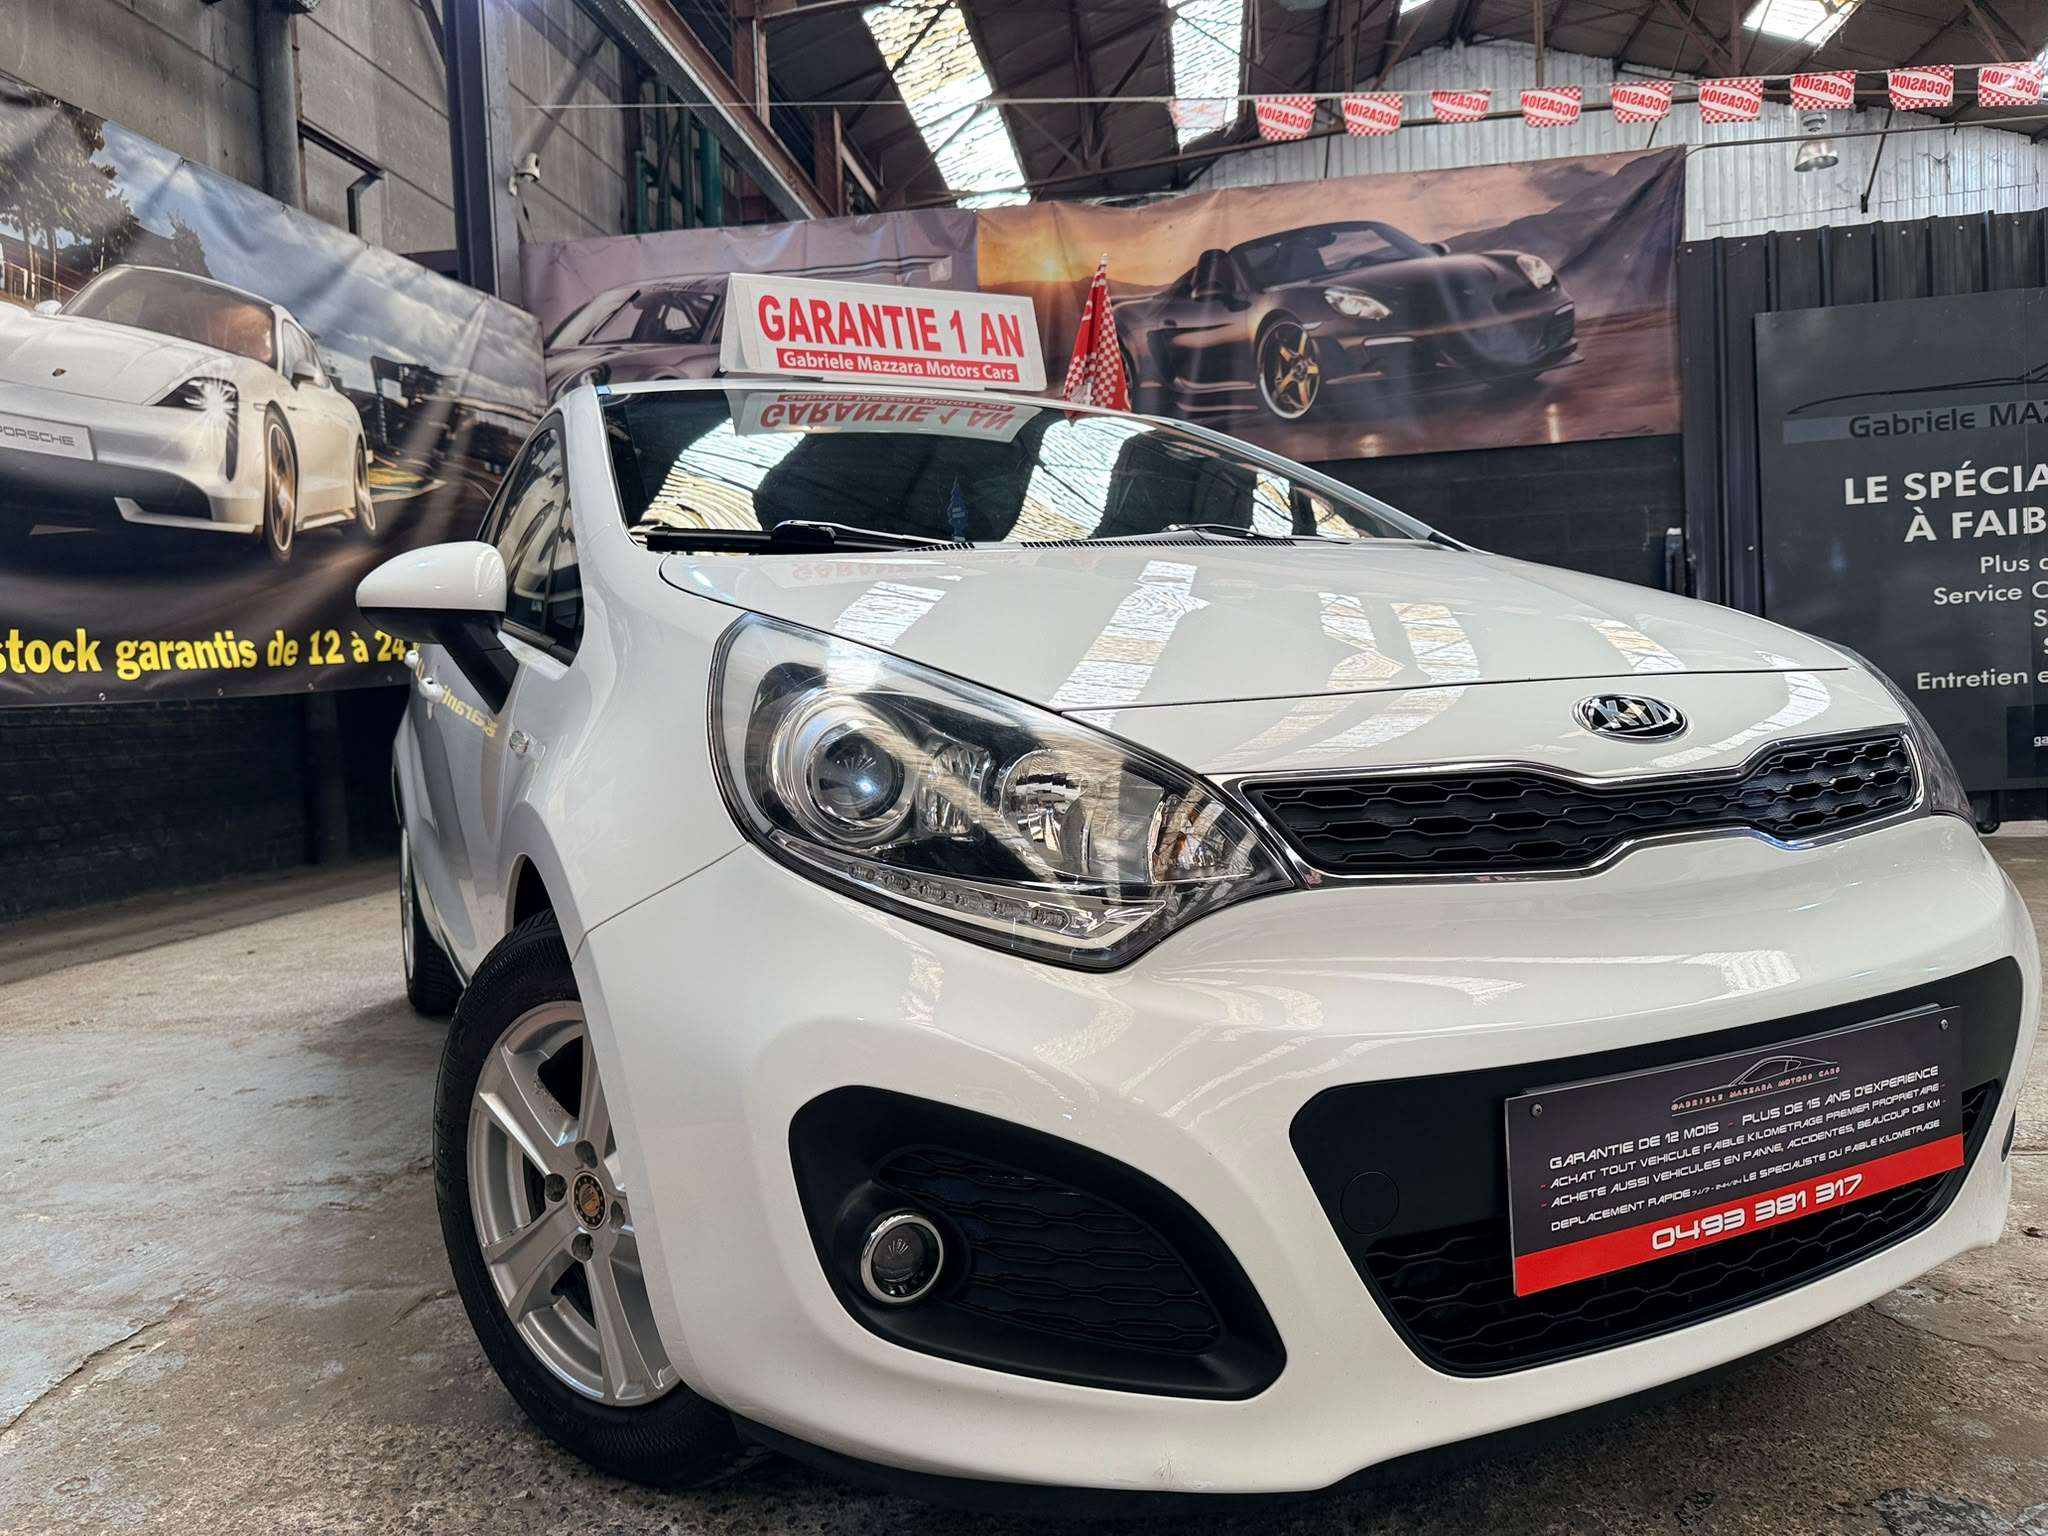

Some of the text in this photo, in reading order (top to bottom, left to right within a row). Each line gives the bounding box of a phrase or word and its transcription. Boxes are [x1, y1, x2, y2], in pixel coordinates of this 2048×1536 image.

[758, 295, 1025, 358] GARANTIE 1 AN
[784, 351, 1015, 381] Gabriele Mazzara Motors Cars
[0, 425, 75, 446] ORSCHE
[1849, 401, 2048, 438] Gabriele MA
[1845, 460, 2048, 505] LE SPÉCIA
[1904, 506, 2047, 542] À FAIB
[1981, 555, 2030, 574] Plus
[1933, 584, 2023, 606] Service
[116, 630, 258, 681] garantis
[267, 629, 299, 668] de
[309, 629, 345, 665] 12
[351, 631, 369, 664] à
[374, 630, 406, 662] 24
[1917, 668, 2028, 690] Entretien
[1597, 699, 1679, 729] KIA
[1550, 1141, 1634, 1170] GARANTIE
[1638, 1135, 1661, 1151] DE
[1665, 1131, 1680, 1144] 12
[1683, 1122, 1720, 1141] MOIS
[1742, 1108, 1781, 1126] PLUS
[1784, 1101, 1804, 1116] DE
[1807, 1097, 1821, 1111] 15
[1824, 1090, 1851, 1106] ANS
[1854, 1066, 1939, 1097] D'EXPERIENCE
[1550, 1169, 1596, 1190] ACHAT
[1600, 1161, 1637, 1177] TOUT
[1640, 1147, 1701, 1169] VEHICULE
[1703, 1135, 1745, 1154] FAIBLE
[1747, 1114, 1823, 1142] KILOMETRAGE
[1826, 1103, 1870, 1122] PREMIER
[1872, 1083, 1940, 1110] PROPRIETAIRE
[1551, 1186, 1607, 1209] ACHETE
[1610, 1176, 1650, 1194] AUSSI
[1653, 1159, 1721, 1183] VEHICULES
[1724, 1153, 1741, 1166] EN
[1743, 1142, 1784, 1161] PANNE,
[1786, 1123, 1855, 1150] ACCIDENTES,
[1857, 1107, 1910, 1130] BEAUCOUP
[1912, 1104, 1925, 1115] DE
[1927, 1099, 1941, 1110] KM
[1551, 1200, 1645, 1232] DEPLACEMENT
[1647, 1189, 1691, 1208] RAPIDE
[1743, 1171, 1757, 1183] LE
[1759, 1152, 1827, 1178] SPECIALISTE
[1828, 1148, 1843, 1160] DU
[1845, 1138, 1878, 1155] FAIBLE
[1879, 1119, 1941, 1145] KILOMETRAGE
[1652, 1173, 1863, 1251] 0493 381 317
